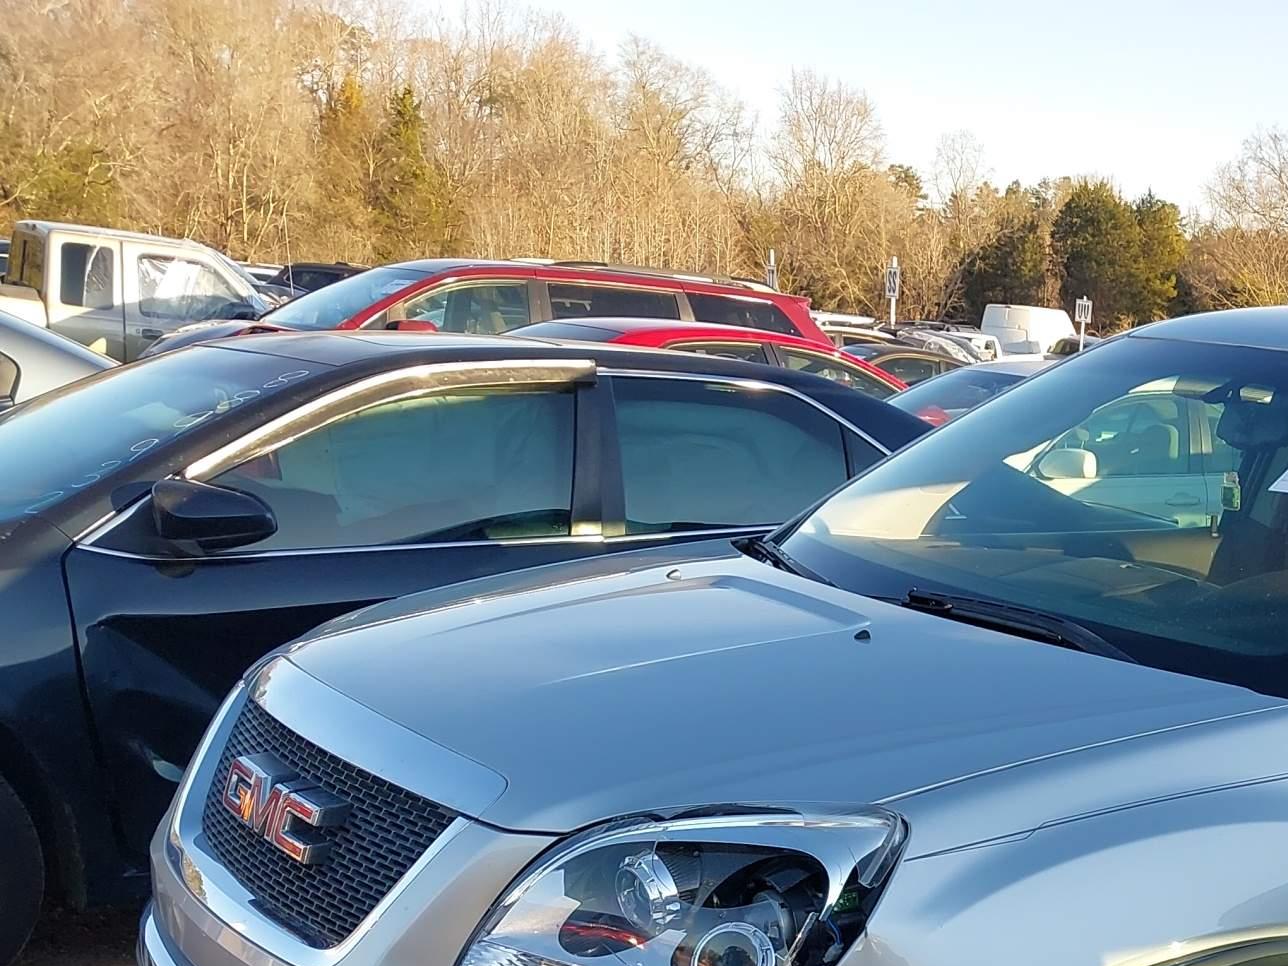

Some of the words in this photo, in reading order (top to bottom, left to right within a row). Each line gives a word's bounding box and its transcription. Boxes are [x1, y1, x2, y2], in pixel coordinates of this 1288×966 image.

[887, 270, 898, 293] SS
[1077, 302, 1090, 320] UU
[223, 757, 323, 865] GMC
